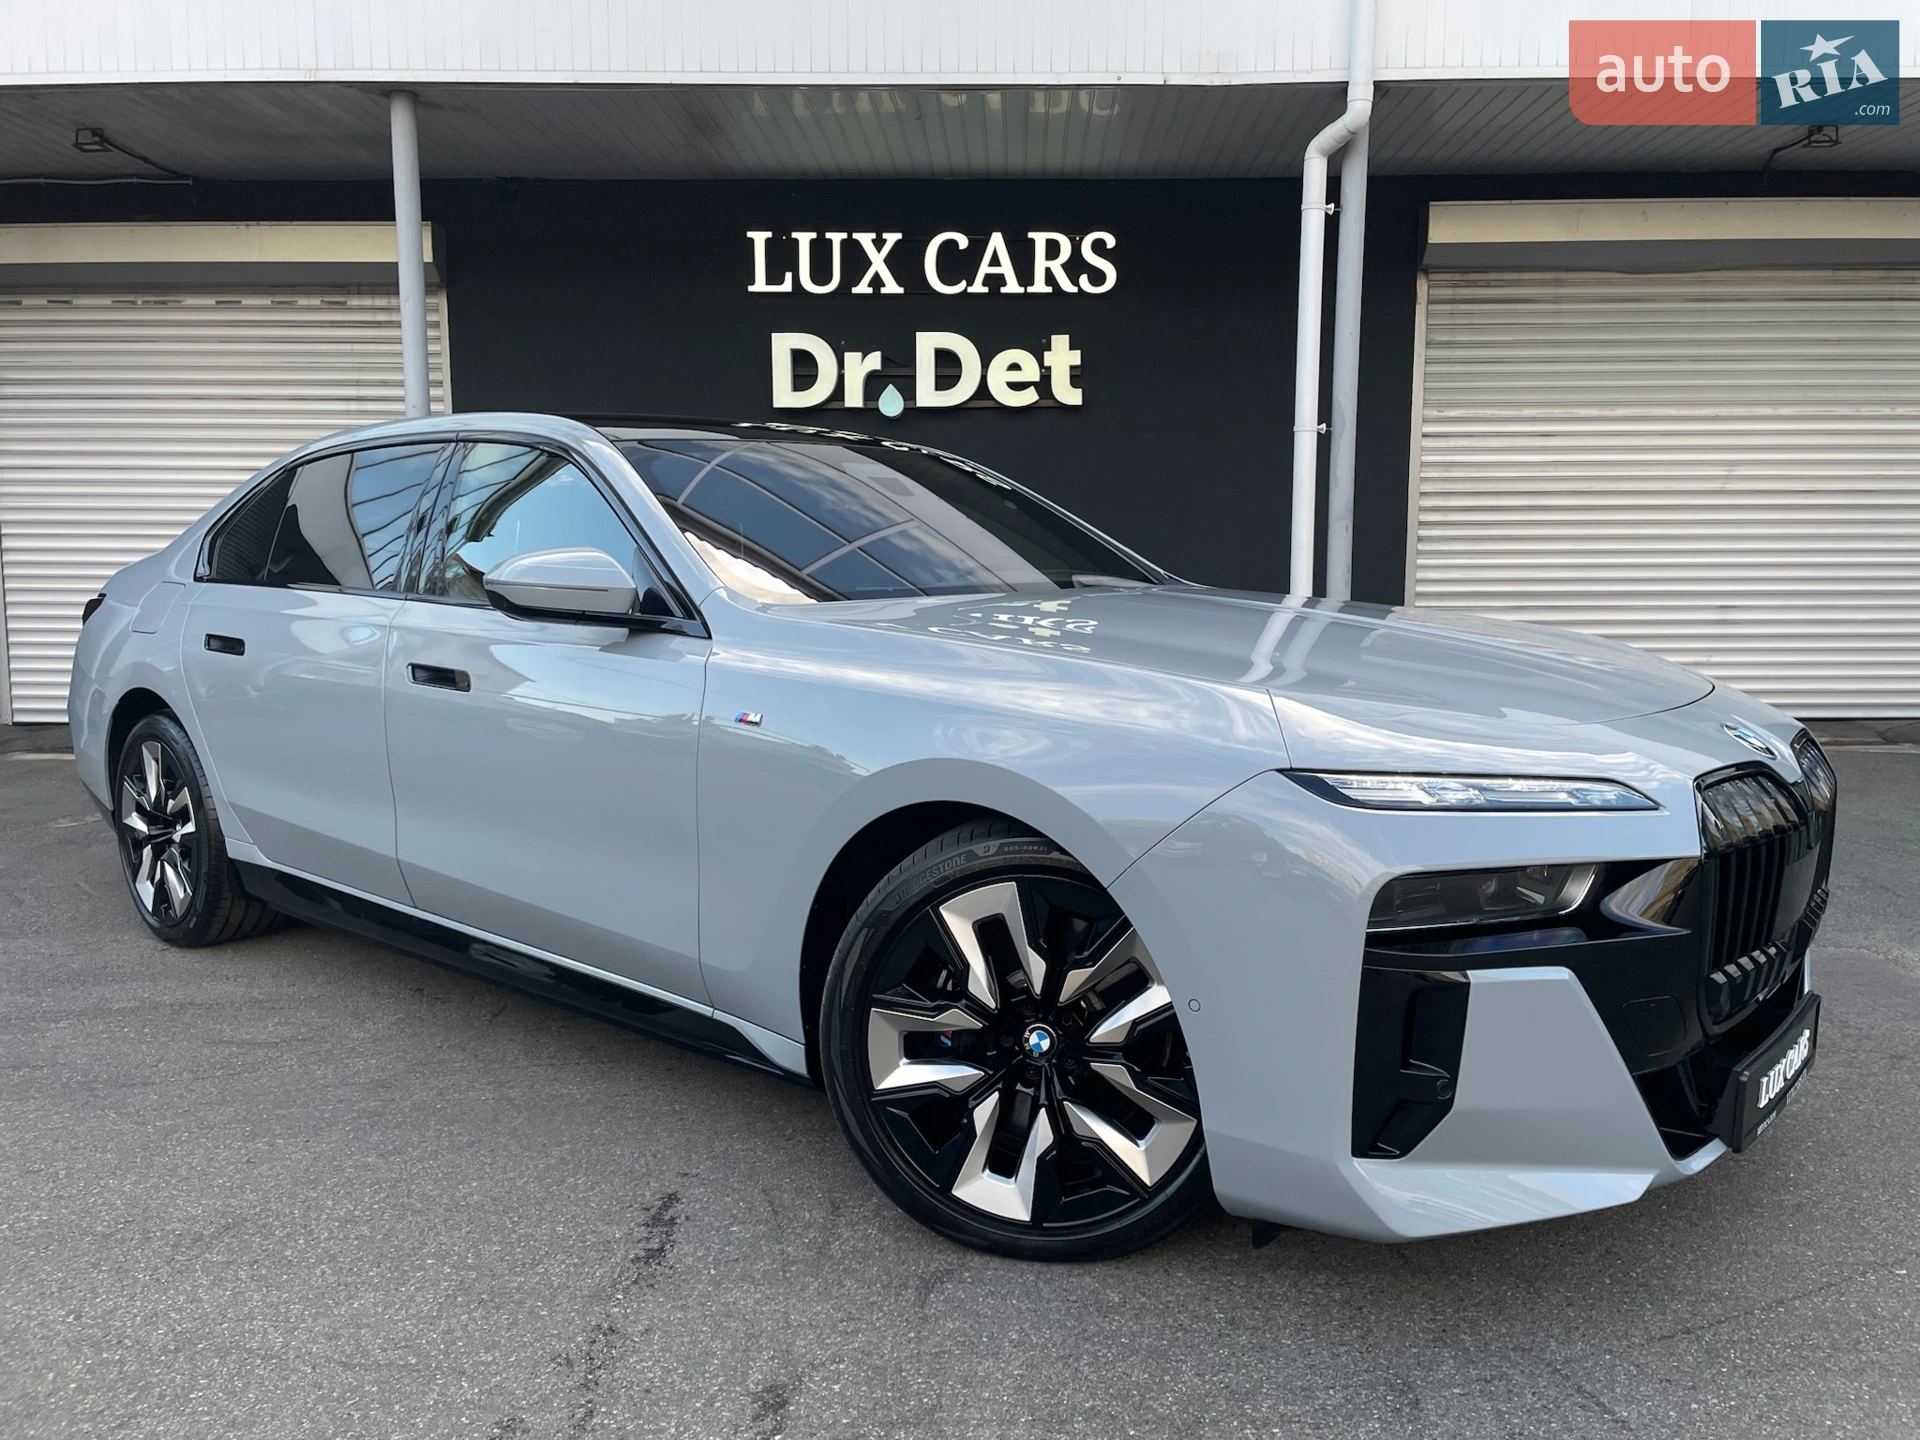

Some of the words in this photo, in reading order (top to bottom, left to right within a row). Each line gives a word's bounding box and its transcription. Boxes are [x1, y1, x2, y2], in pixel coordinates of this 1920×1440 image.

[746, 230, 905, 295] LUX
[923, 230, 1118, 295] CARS
[1757, 1058, 1786, 1109] LUX
